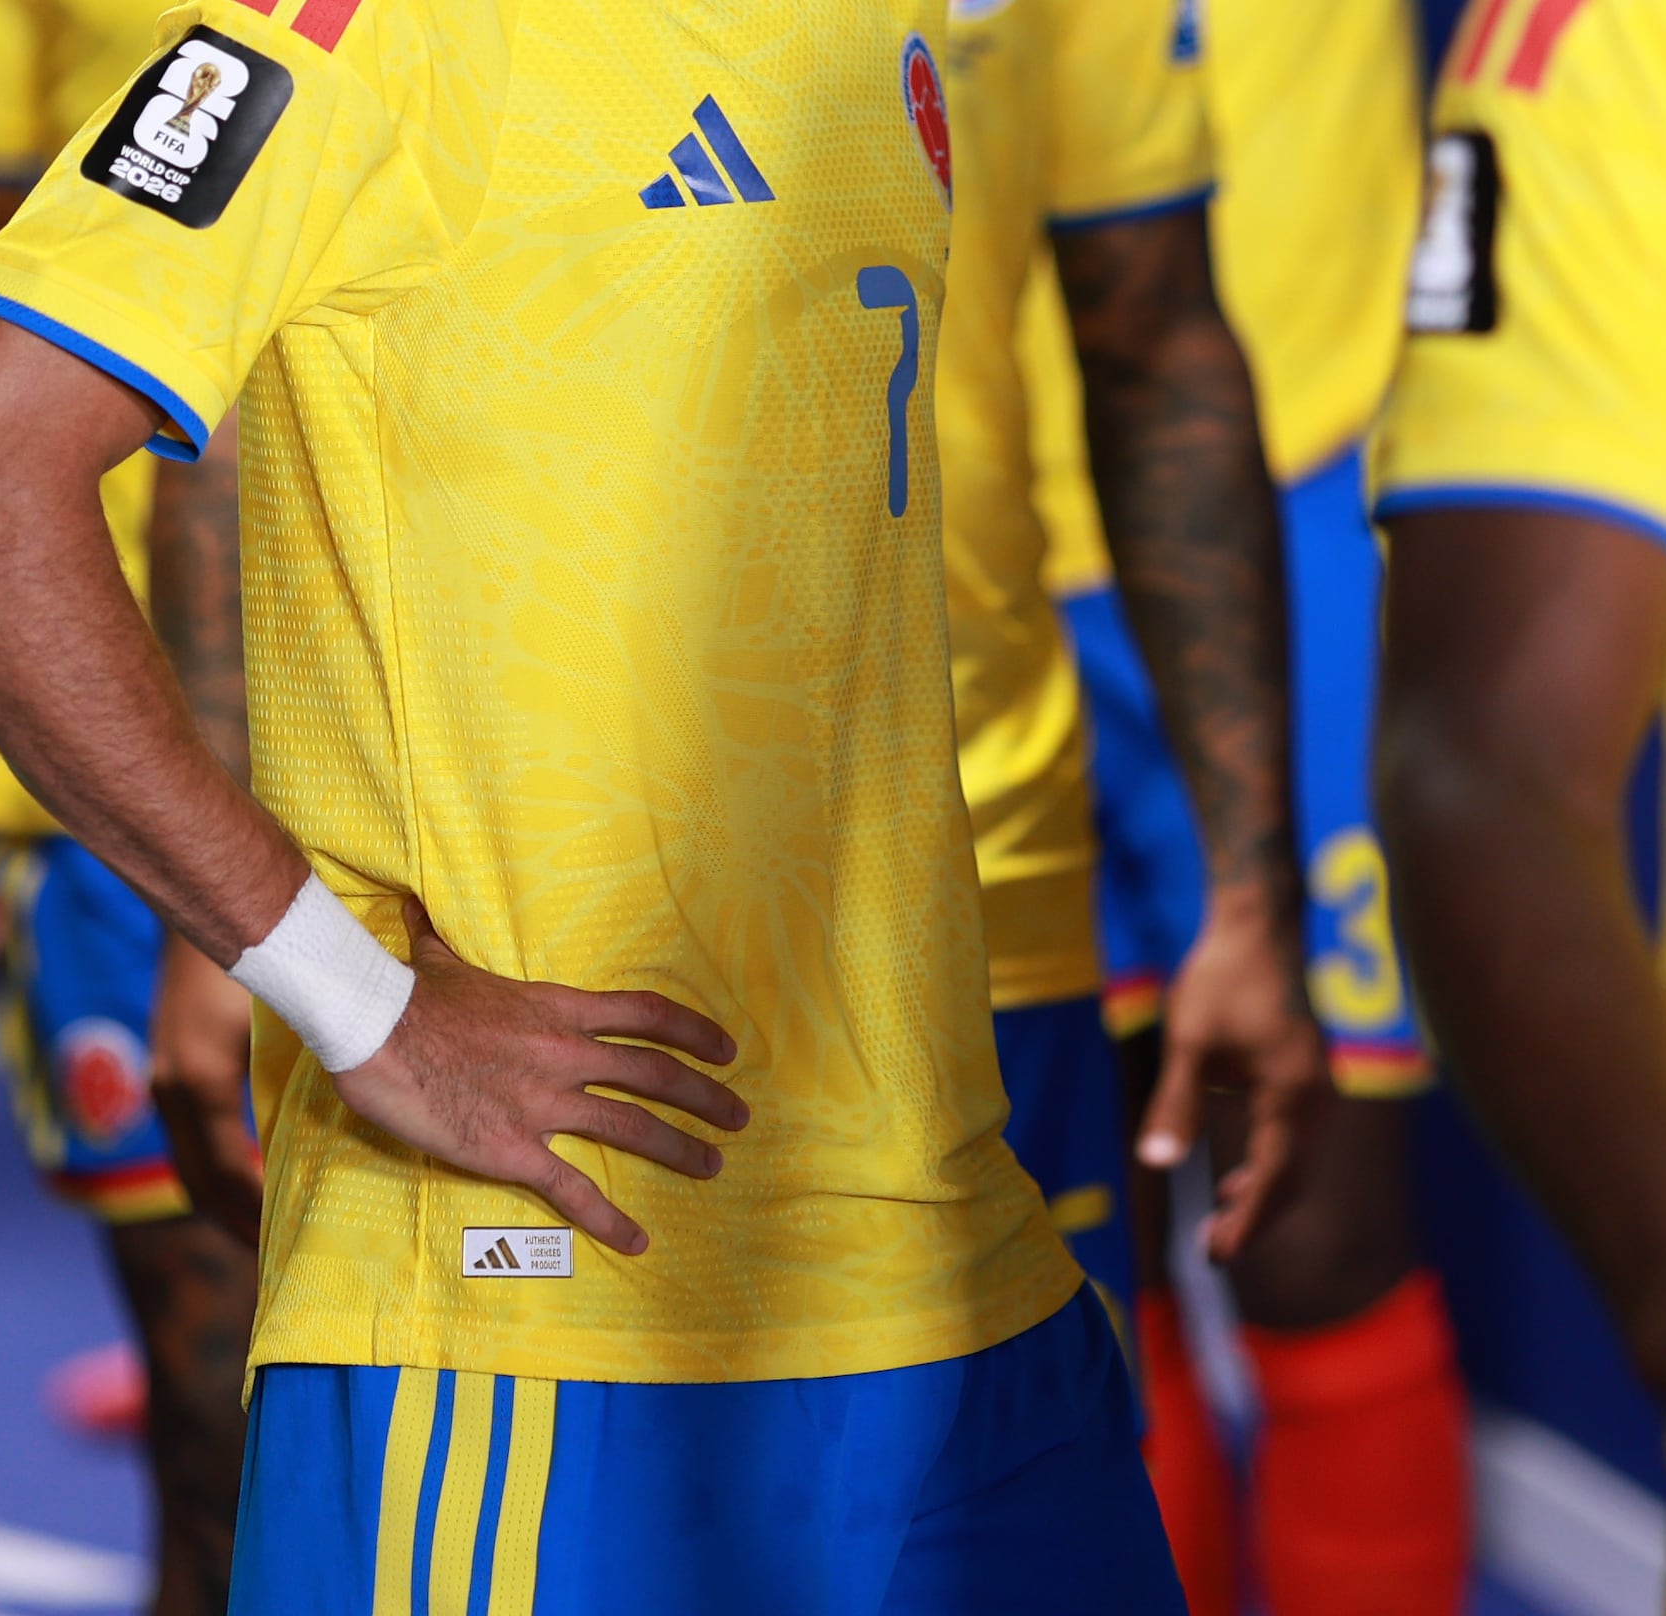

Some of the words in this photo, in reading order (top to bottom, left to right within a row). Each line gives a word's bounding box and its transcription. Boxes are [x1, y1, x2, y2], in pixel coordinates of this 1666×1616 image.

[153, 130, 186, 155] FIFA
[108, 157, 183, 203] 2026
[120, 145, 166, 175] WORLD
[164, 169, 191, 186] CUP
[857, 265, 919, 518] 7
[1308, 823, 1404, 1032] 3
[531, 1260, 561, 1270] PRODUCT
